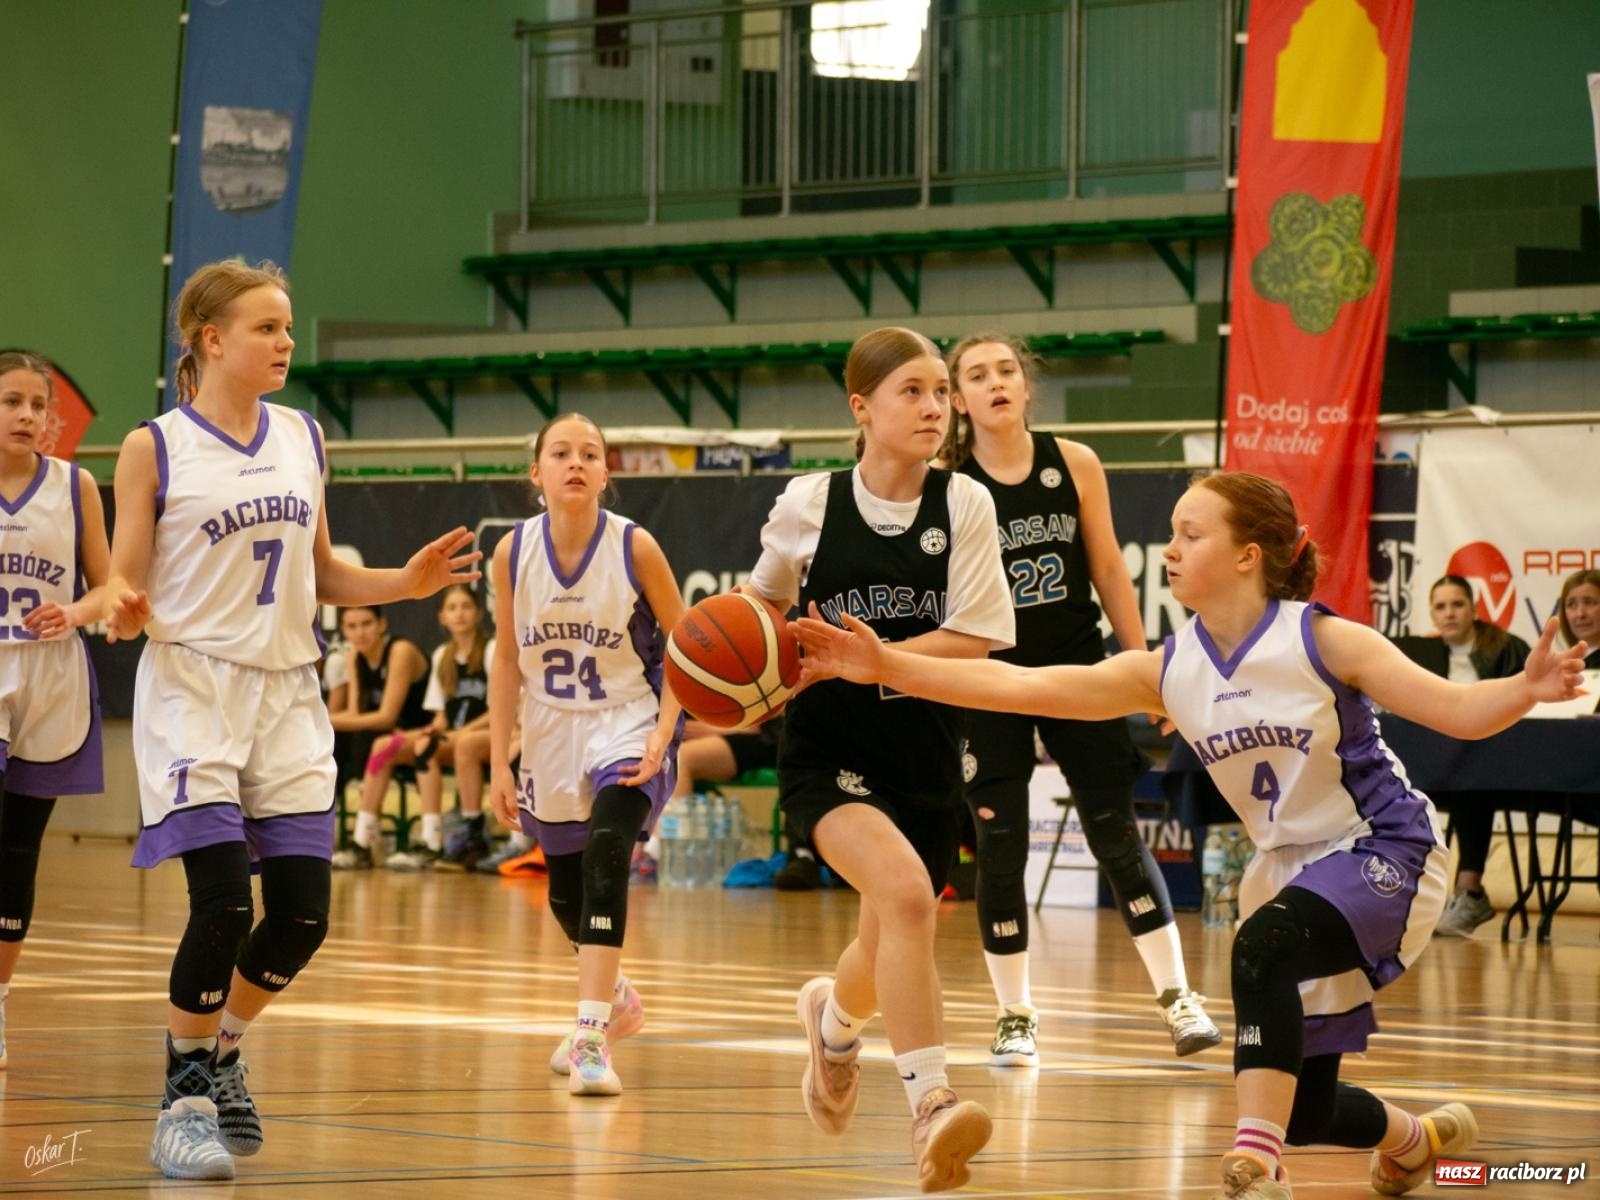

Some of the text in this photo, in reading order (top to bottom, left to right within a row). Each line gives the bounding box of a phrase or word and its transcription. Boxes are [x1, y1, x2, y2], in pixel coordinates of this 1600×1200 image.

[1236, 394, 1310, 430] Dodaj
[1233, 426, 1325, 455] od siebie
[200, 490, 313, 546] RACIBÓR
[997, 513, 1077, 553] ARSAW
[252, 538, 284, 606] 7
[1009, 552, 1067, 609] 22
[541, 648, 607, 701] 24
[1250, 760, 1281, 822] 4
[595, 916, 612, 930] NBA
[269, 973, 290, 986] NBA
